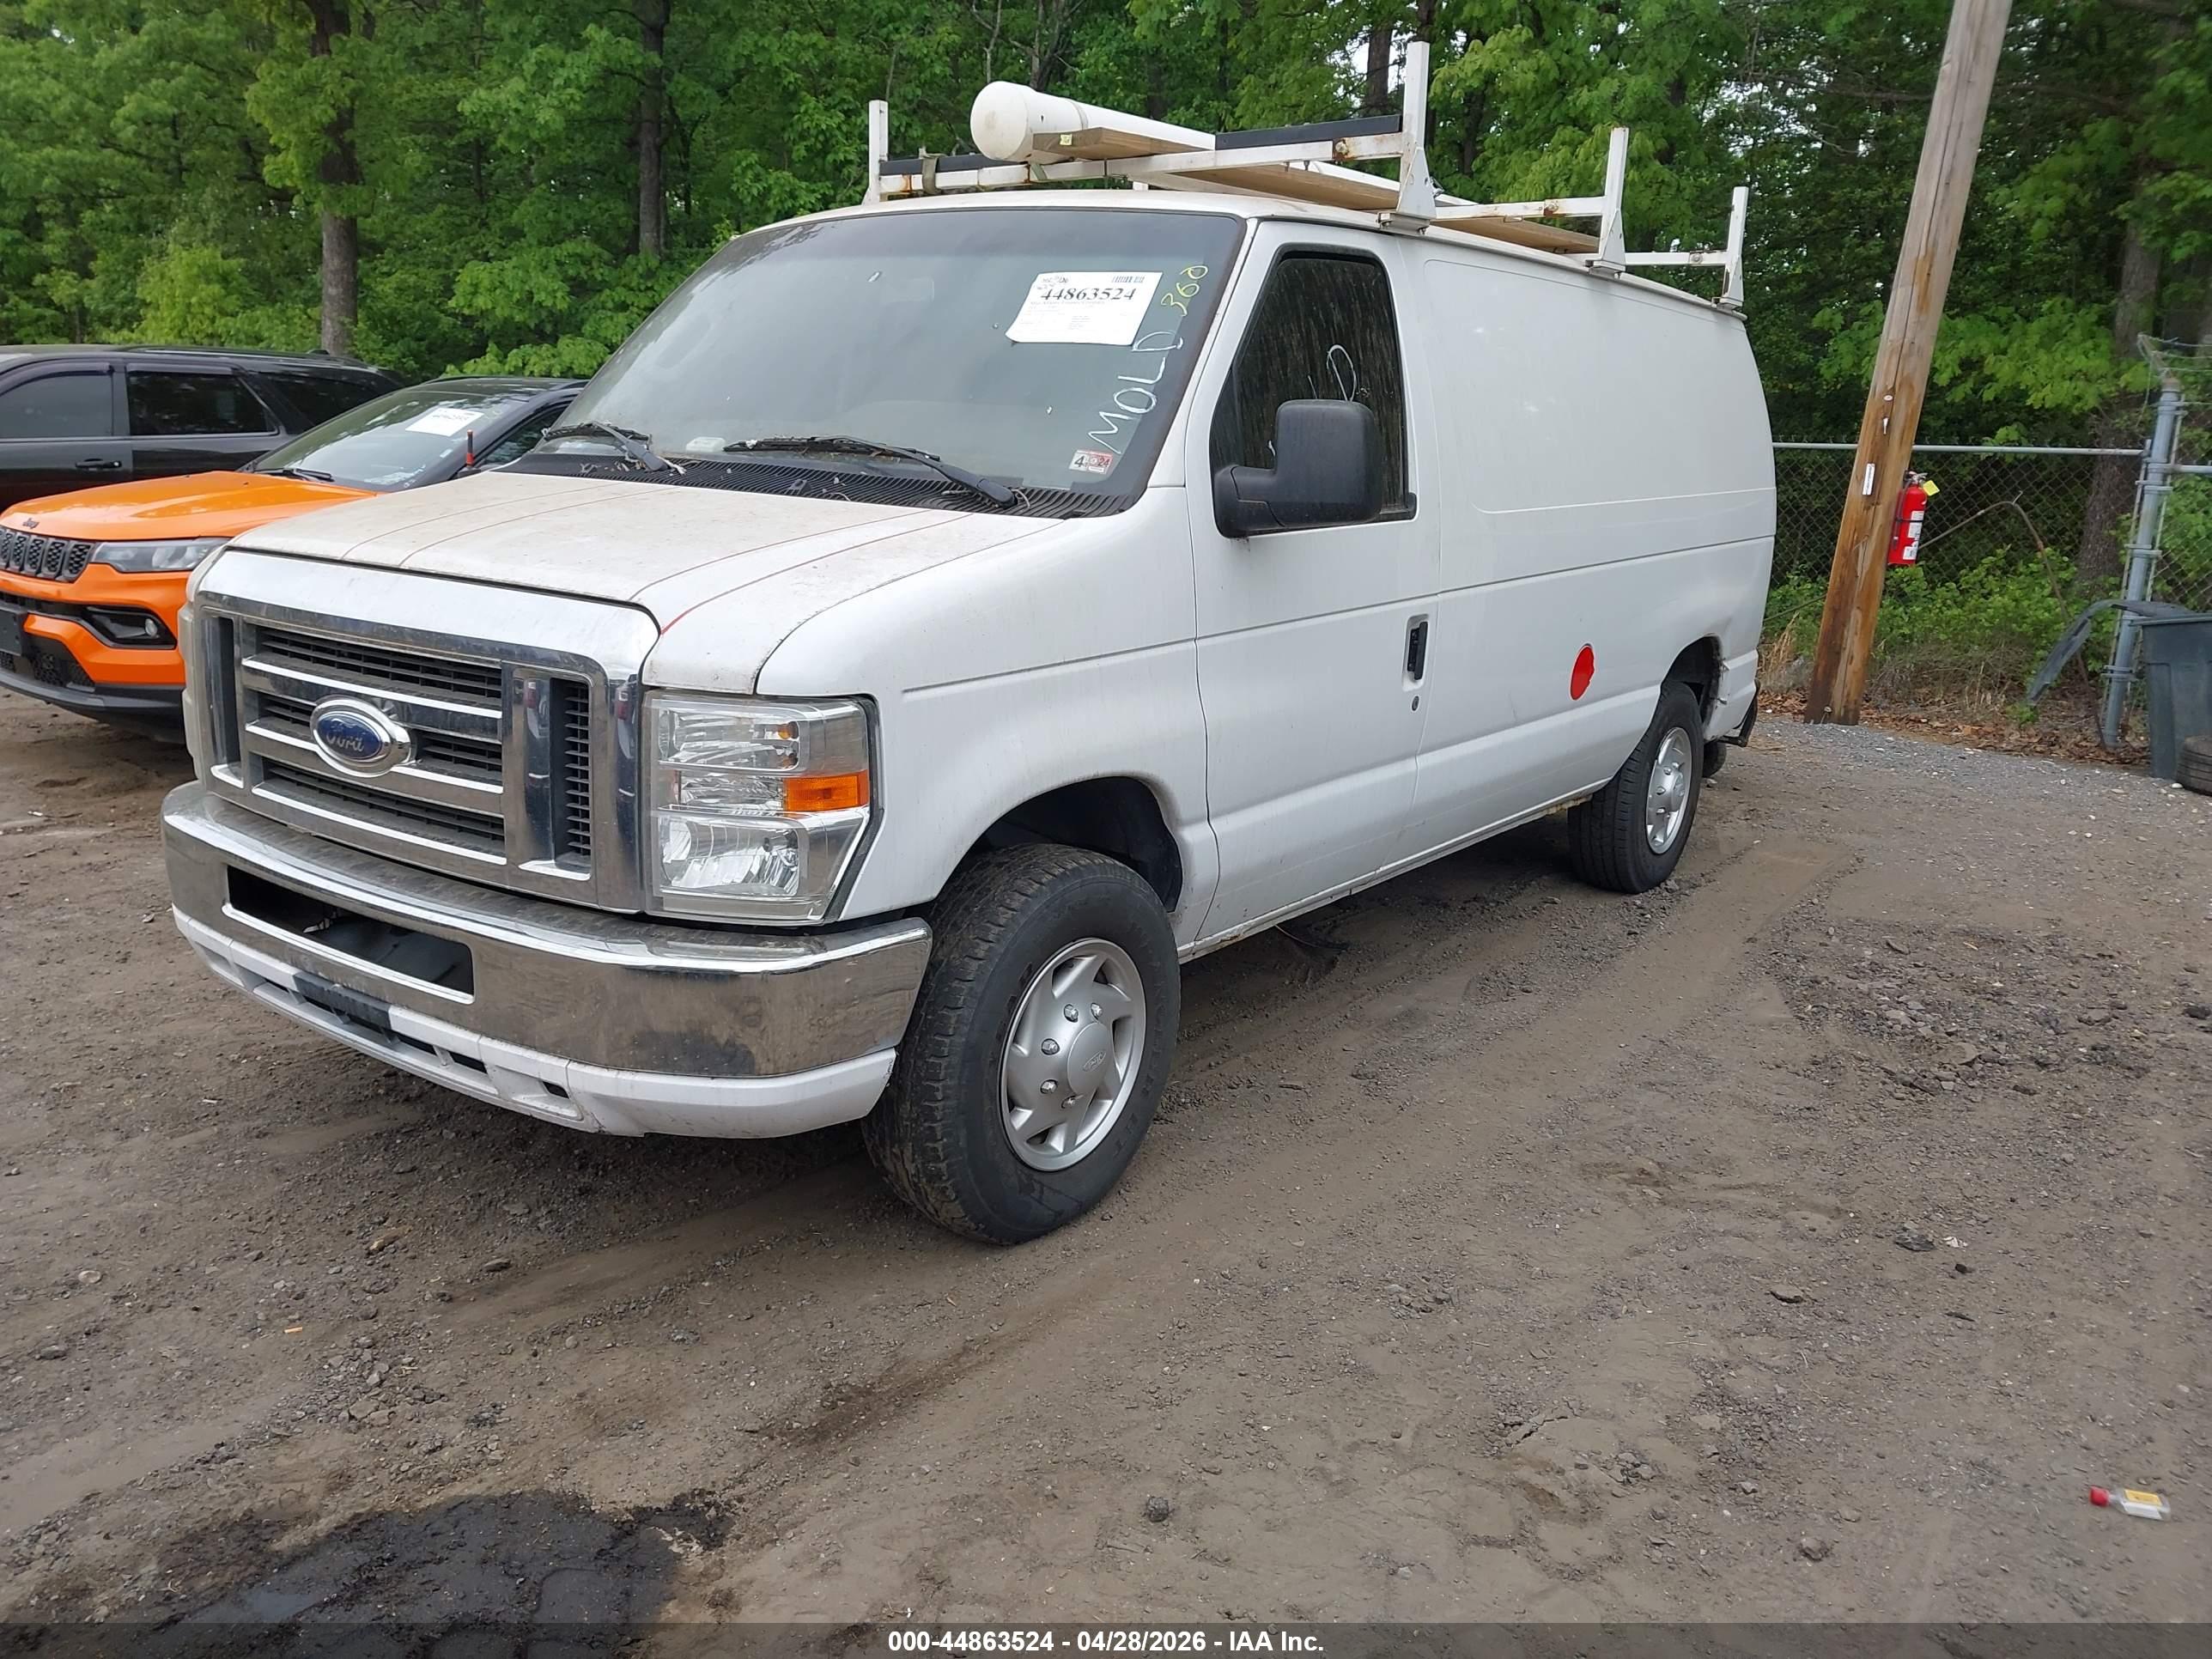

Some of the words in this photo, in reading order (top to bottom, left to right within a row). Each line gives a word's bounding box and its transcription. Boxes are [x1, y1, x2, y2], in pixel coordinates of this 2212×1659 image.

[1039, 288, 1137, 301] 44863524
[1161, 264, 1208, 316] 360
[1087, 331, 1184, 454] MOLD
